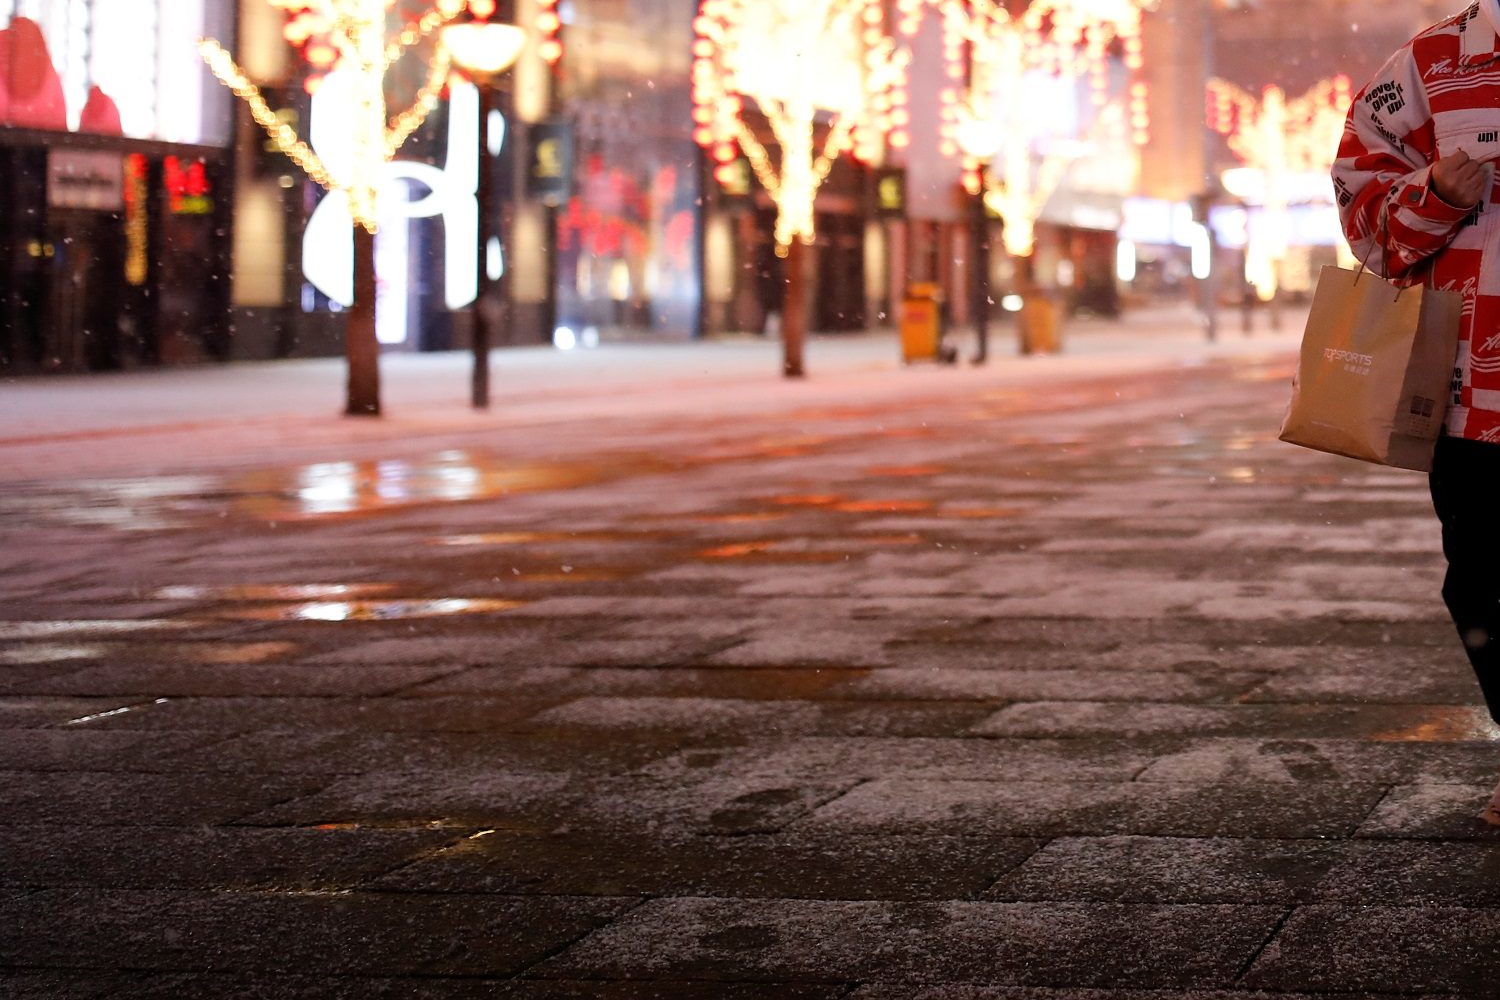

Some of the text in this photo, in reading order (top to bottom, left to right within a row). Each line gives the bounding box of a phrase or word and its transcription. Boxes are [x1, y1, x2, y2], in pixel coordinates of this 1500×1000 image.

[1365, 80, 1396, 103] never
[1372, 91, 1397, 112] give
[1387, 97, 1405, 115] up!
[1477, 131, 1498, 143] up!
[1323, 348, 1373, 366] TOPSPORTS
